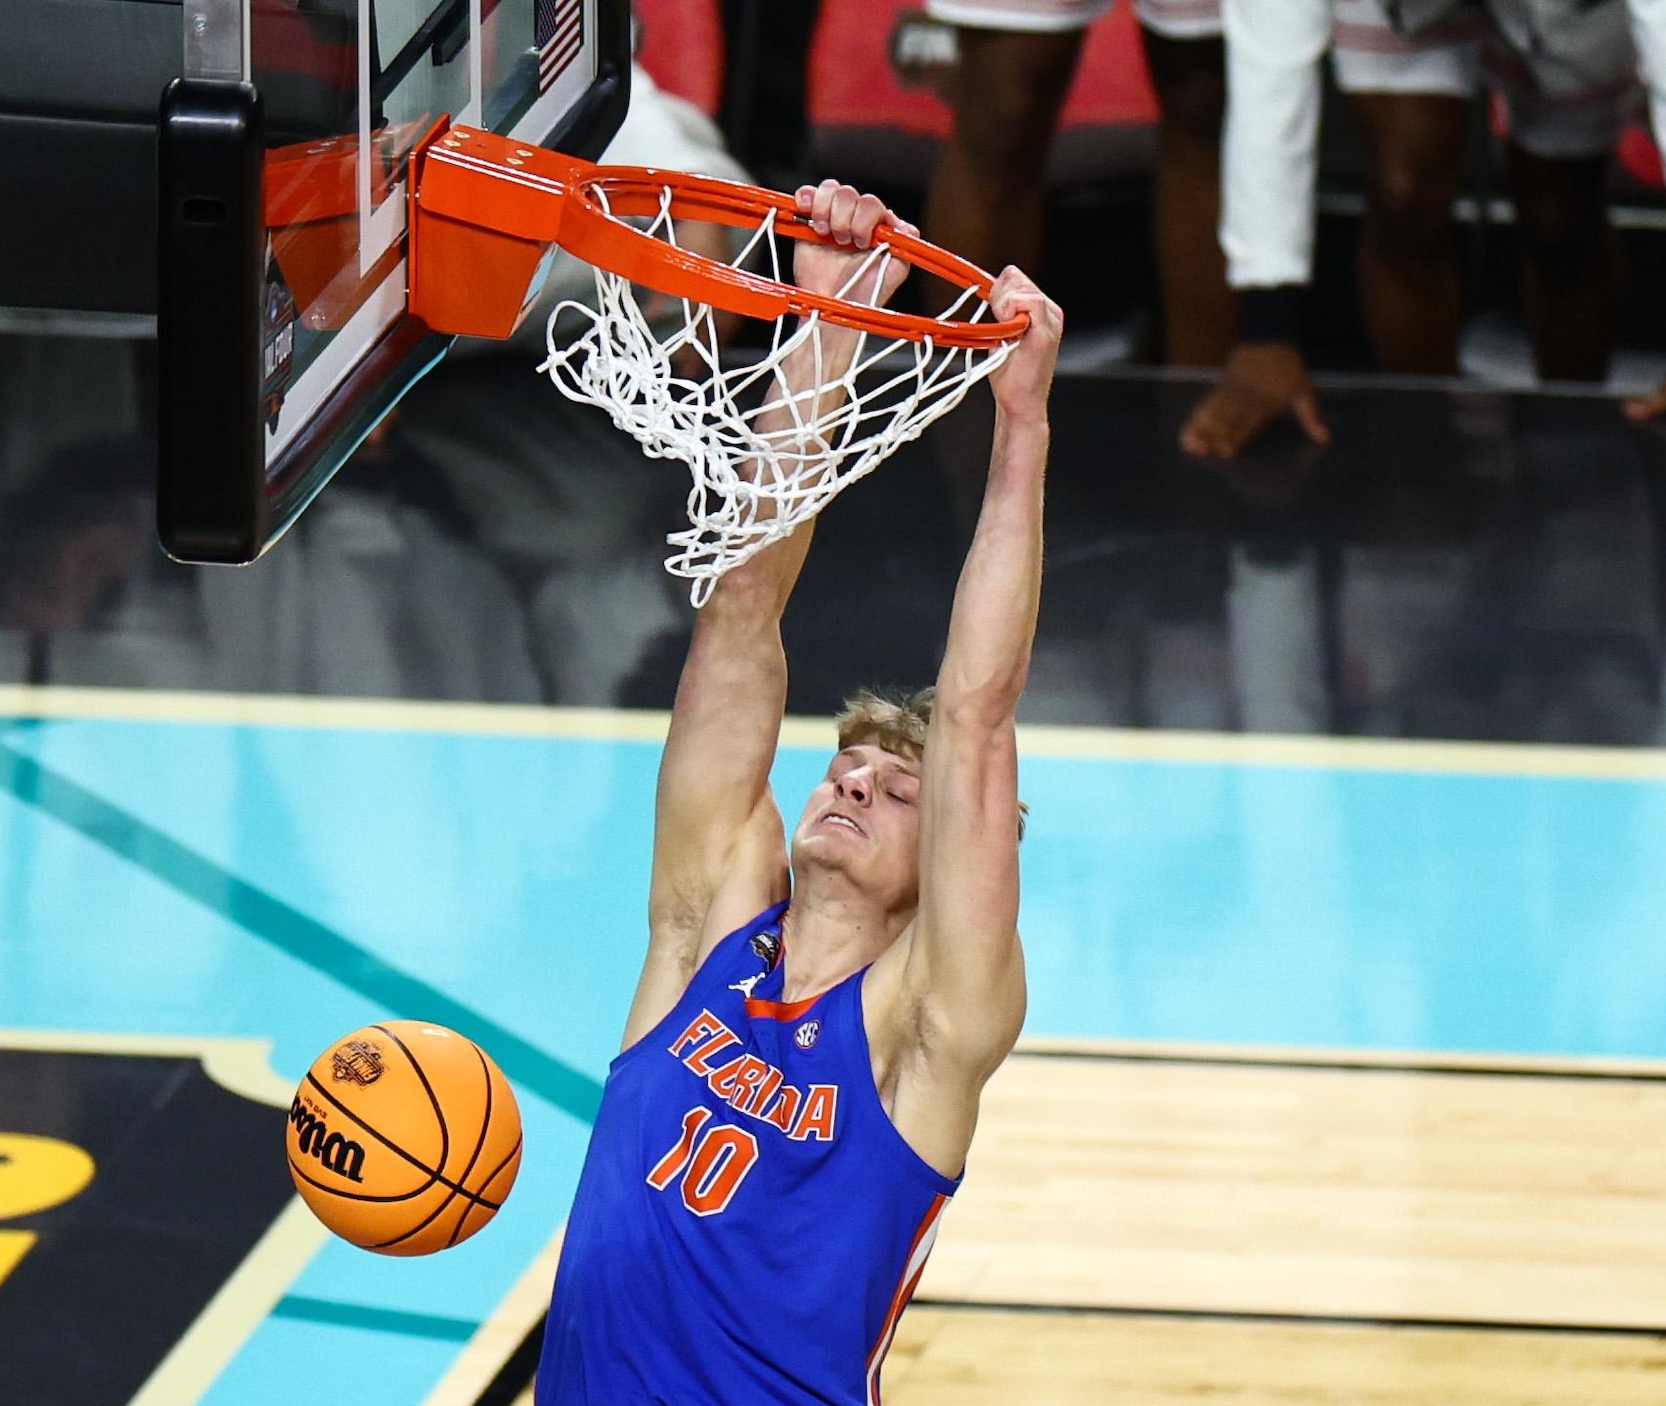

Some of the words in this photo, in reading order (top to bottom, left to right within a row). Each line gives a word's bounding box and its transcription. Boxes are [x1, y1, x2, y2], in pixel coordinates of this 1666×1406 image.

[667, 1008, 839, 1142] FLORIDA
[796, 1022, 819, 1047] SEC
[646, 1105, 760, 1217] 10
